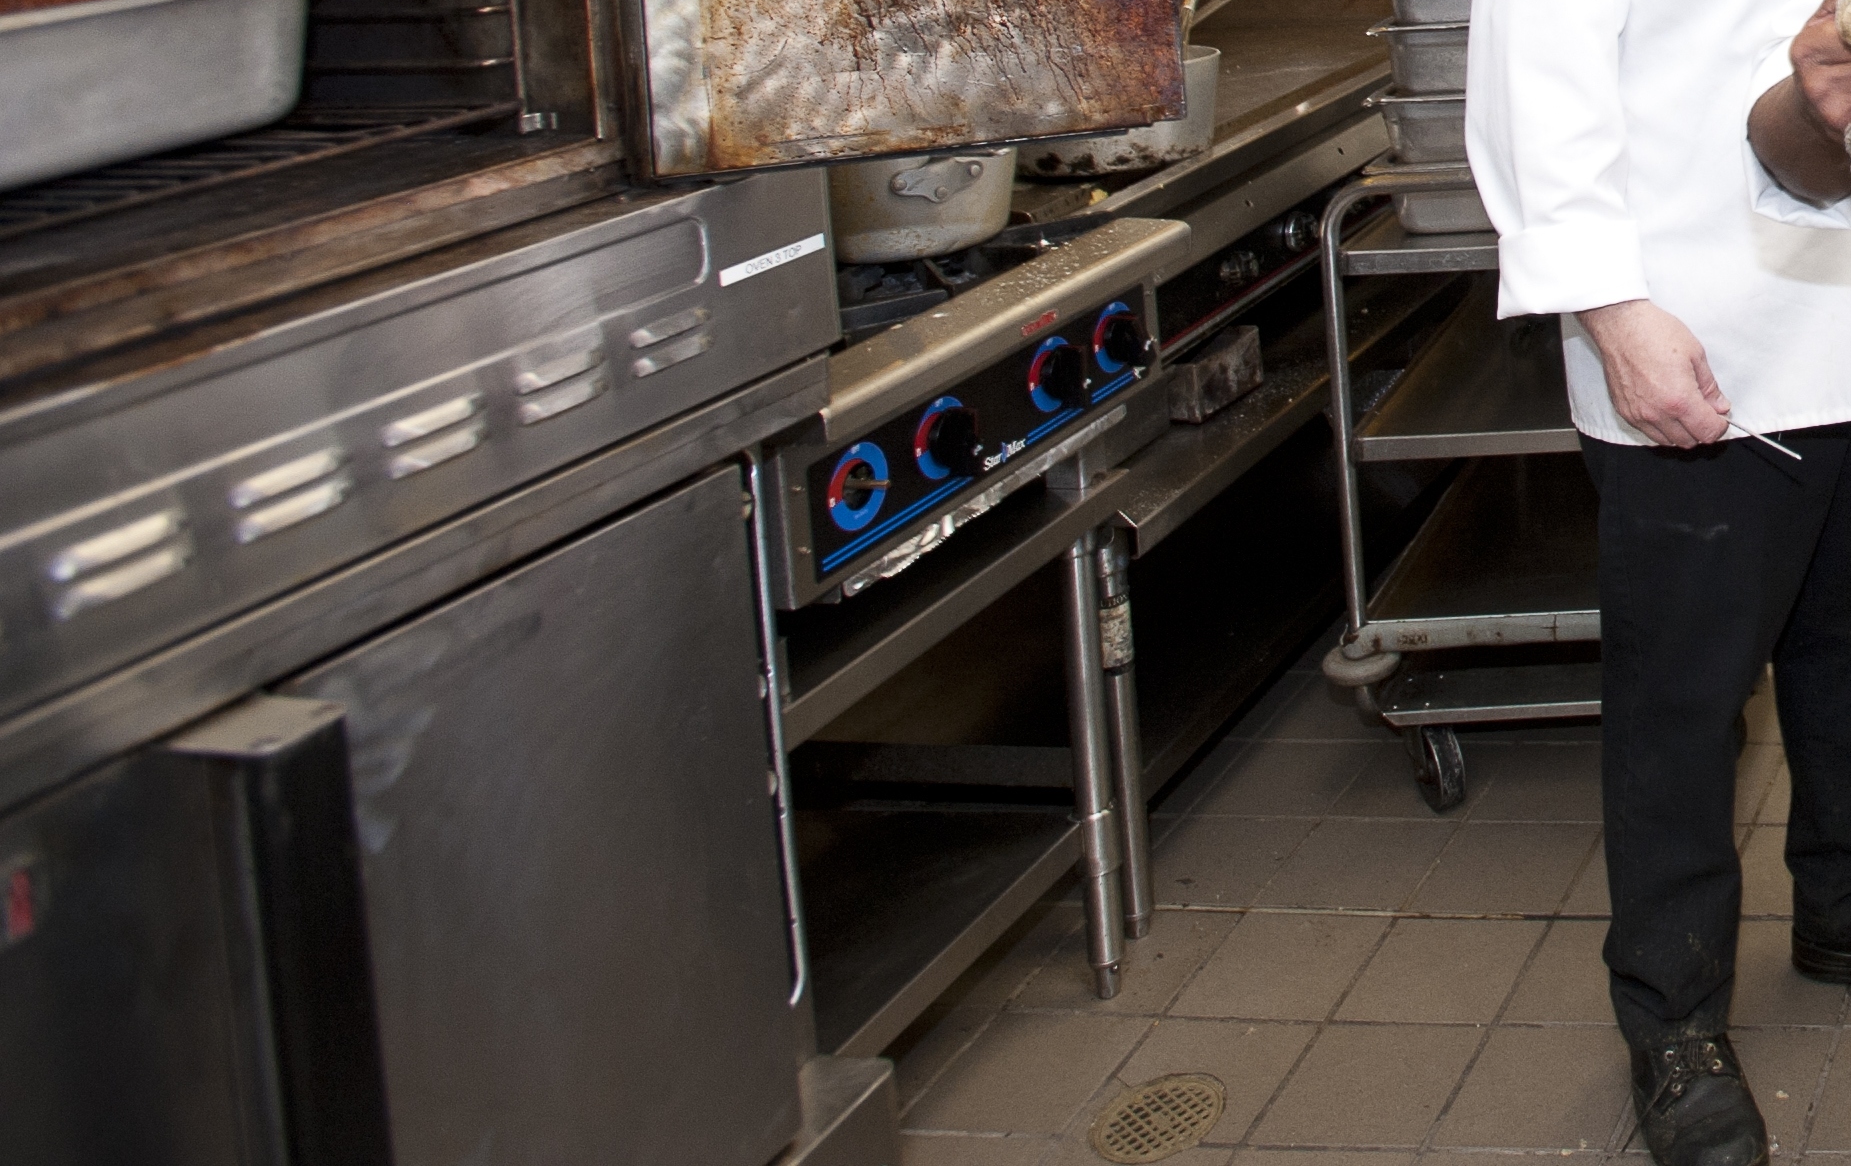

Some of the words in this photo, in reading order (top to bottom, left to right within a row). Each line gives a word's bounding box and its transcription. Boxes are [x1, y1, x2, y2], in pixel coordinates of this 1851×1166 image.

[744, 255, 774, 275] OVEN
[774, 252, 782, 264] 3
[783, 244, 802, 259] TOP
